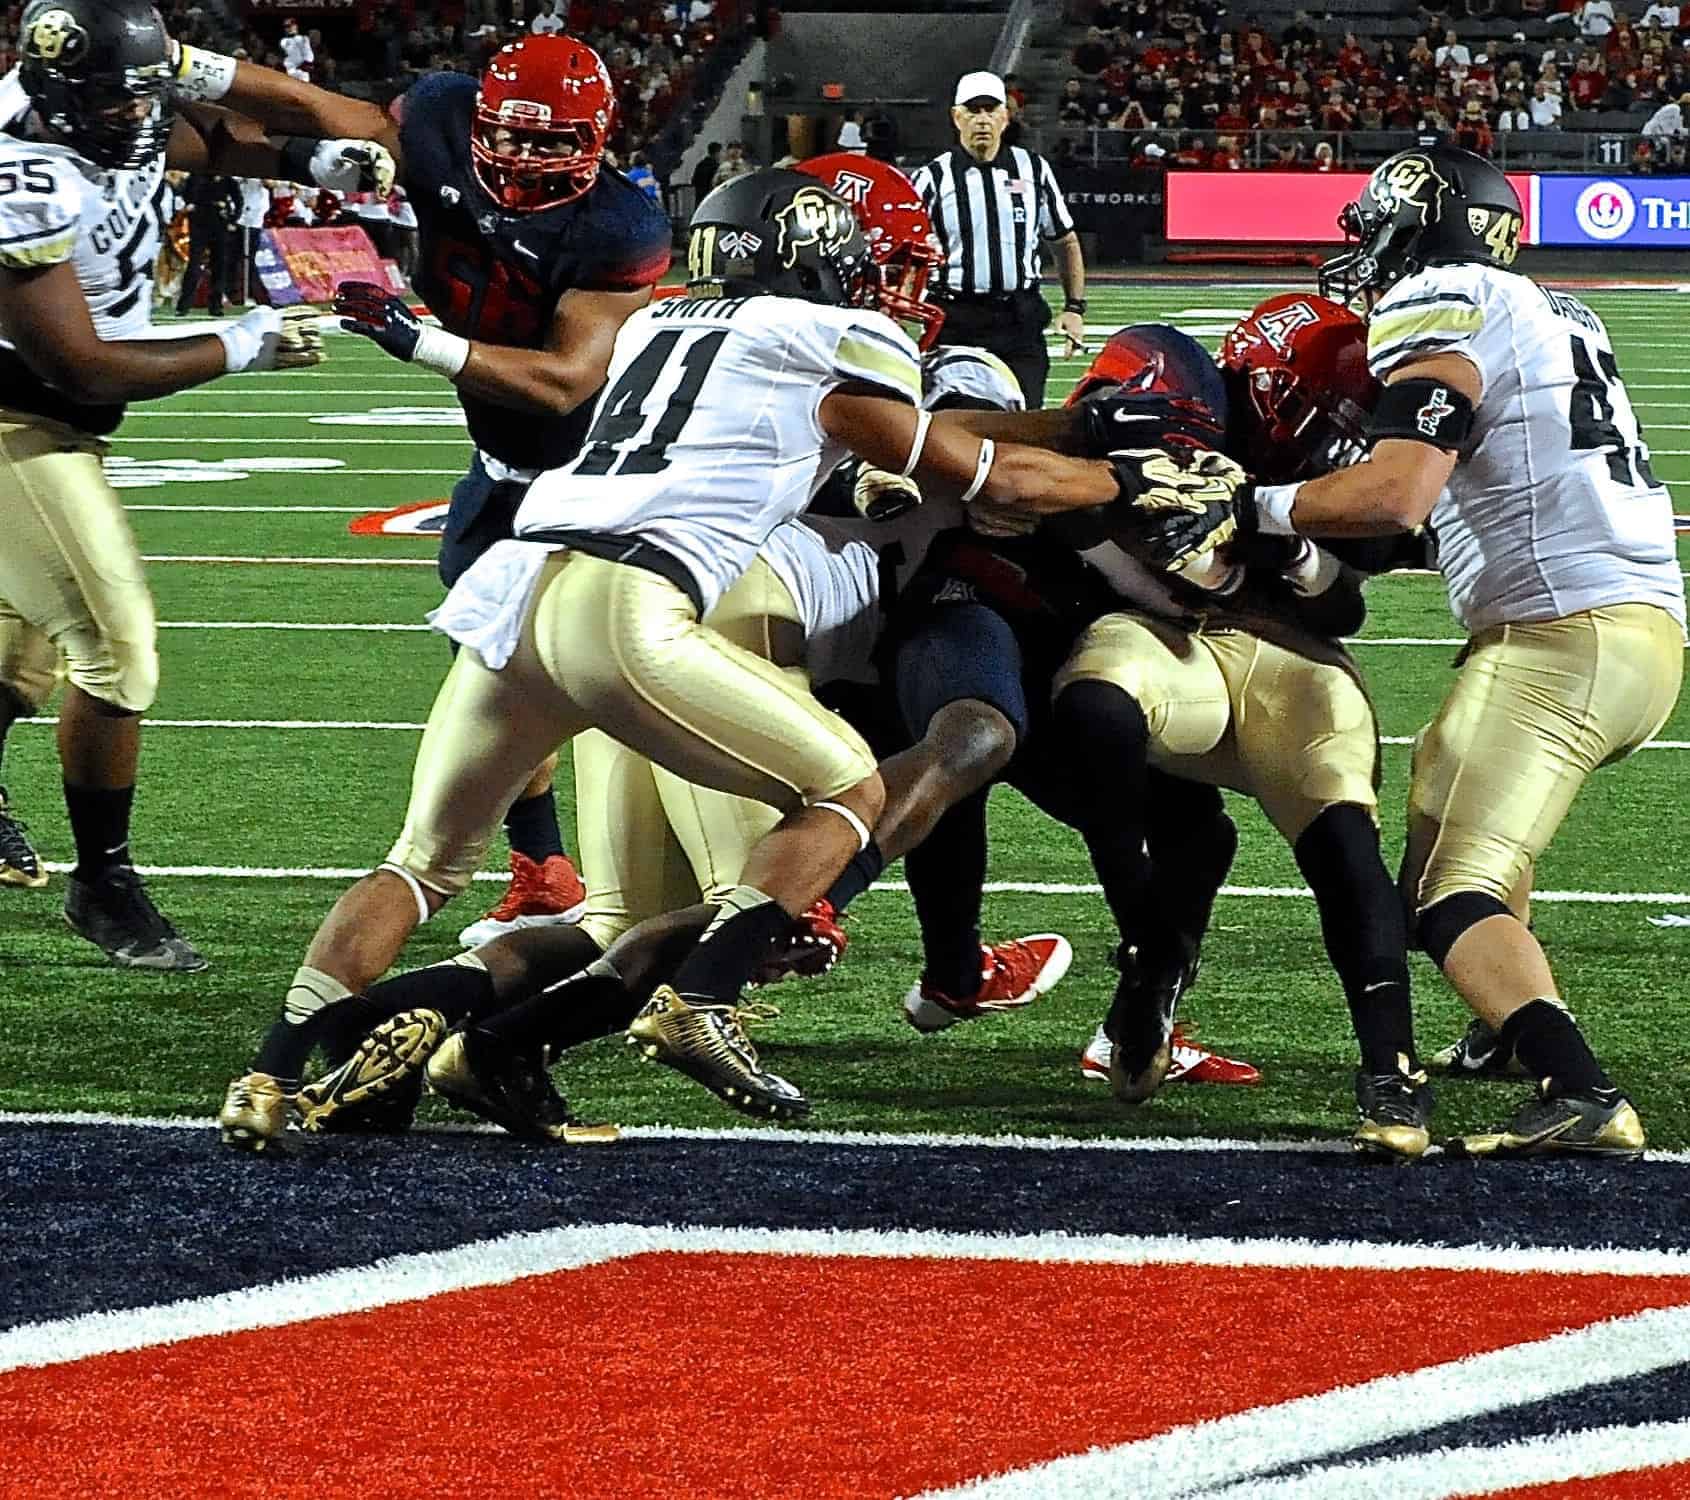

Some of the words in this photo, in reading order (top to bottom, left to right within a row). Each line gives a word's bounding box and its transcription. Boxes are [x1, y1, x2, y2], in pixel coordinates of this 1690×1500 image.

[1600, 142, 1621, 163] 11
[1063, 192, 1161, 204] ETWORKS
[1387, 159, 1431, 200] CU
[795, 194, 837, 239] CU
[1641, 198, 1690, 229] TH
[688, 226, 716, 281] 41
[1485, 211, 1522, 265] 43
[651, 297, 751, 319] SMITH
[1254, 301, 1321, 353] A
[571, 330, 729, 476] 41
